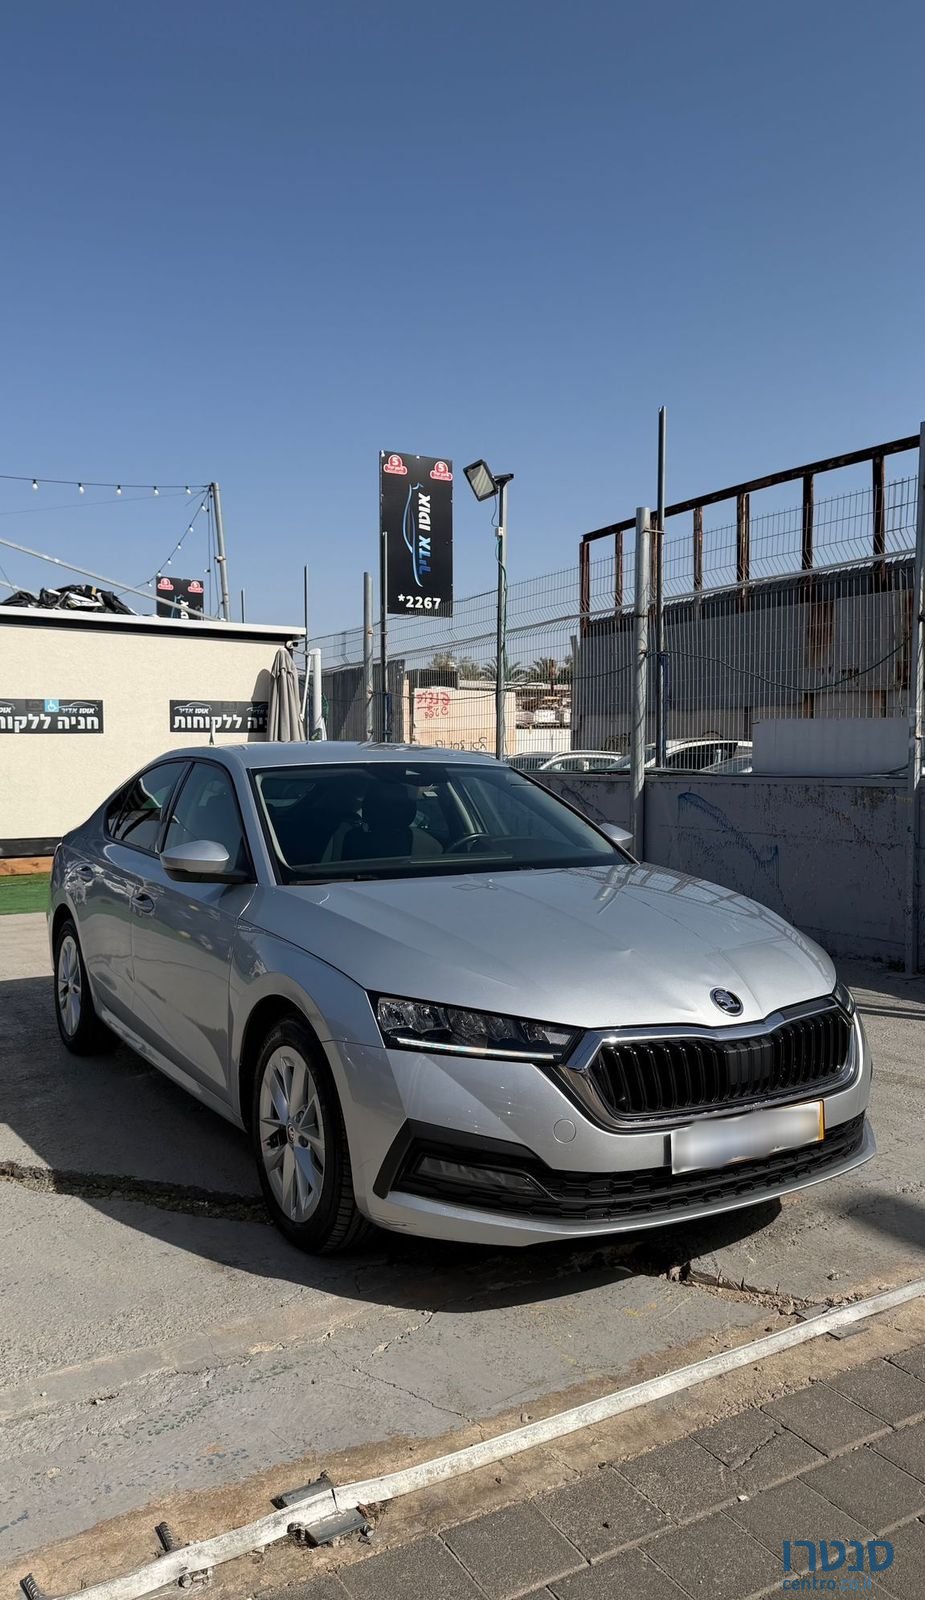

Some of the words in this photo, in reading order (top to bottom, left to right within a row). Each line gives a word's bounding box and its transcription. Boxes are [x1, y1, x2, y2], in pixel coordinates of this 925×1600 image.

[418, 492, 431, 531] אוטו
[57, 716, 99, 729] חניה
[173, 714, 242, 731] ללקוחות
